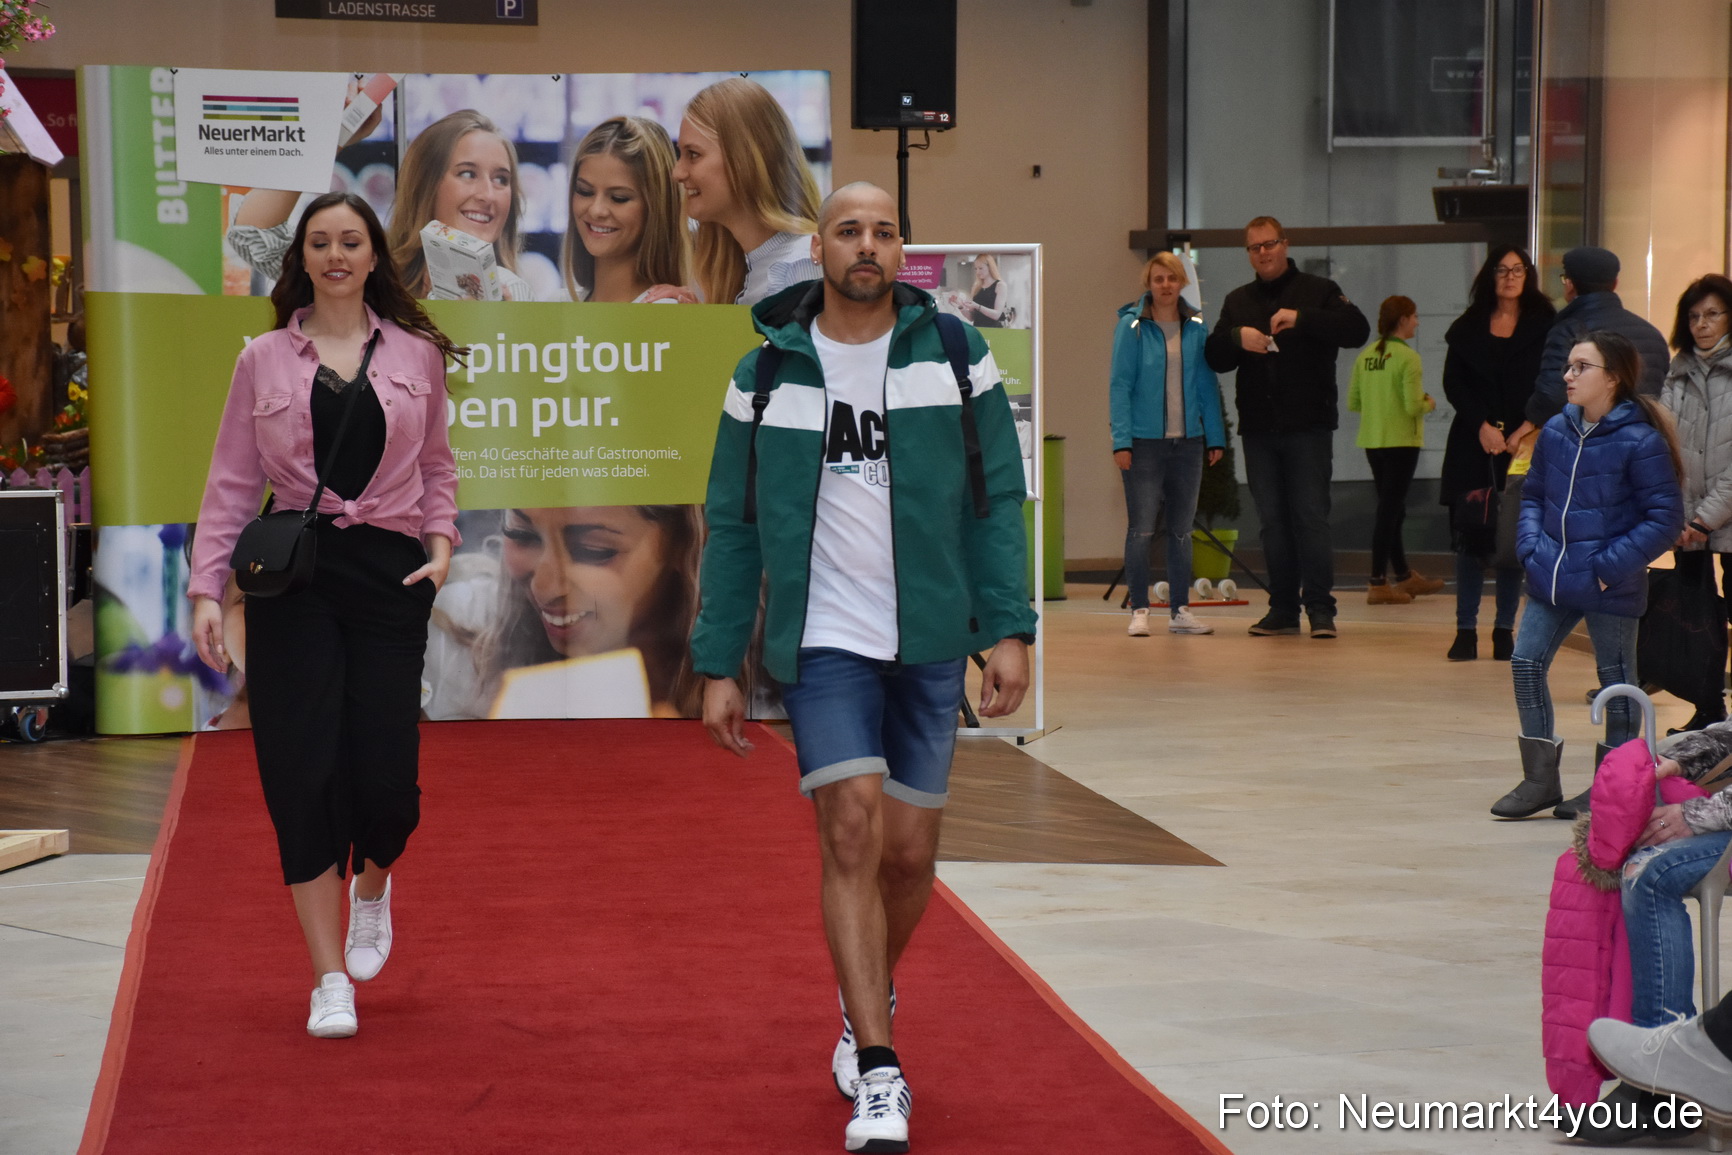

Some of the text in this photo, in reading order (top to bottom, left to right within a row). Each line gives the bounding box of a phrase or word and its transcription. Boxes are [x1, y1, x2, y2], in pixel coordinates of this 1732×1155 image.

[328, 1, 436, 18] LADENSTRASSE
[939, 113, 949, 121] 12
[198, 123, 306, 143] NeuerMarkt
[204, 146, 304, 157] Alles unter einem Dach.
[1364, 357, 1386, 371] TEAM
[1005, 377, 1021, 385] Uhr.
[532, 396, 619, 437] pur.
[826, 400, 888, 463] AC
[480, 447, 499, 461] 40
[501, 446, 570, 461] Geschäfte
[572, 446, 595, 460] auf
[597, 446, 682, 461] Gastronomie,
[480, 465, 497, 479] Da
[500, 465, 517, 479] ist
[519, 465, 539, 478] für
[541, 465, 579, 481] jeden
[581, 467, 609, 478] was
[611, 464, 650, 478] dabei.
